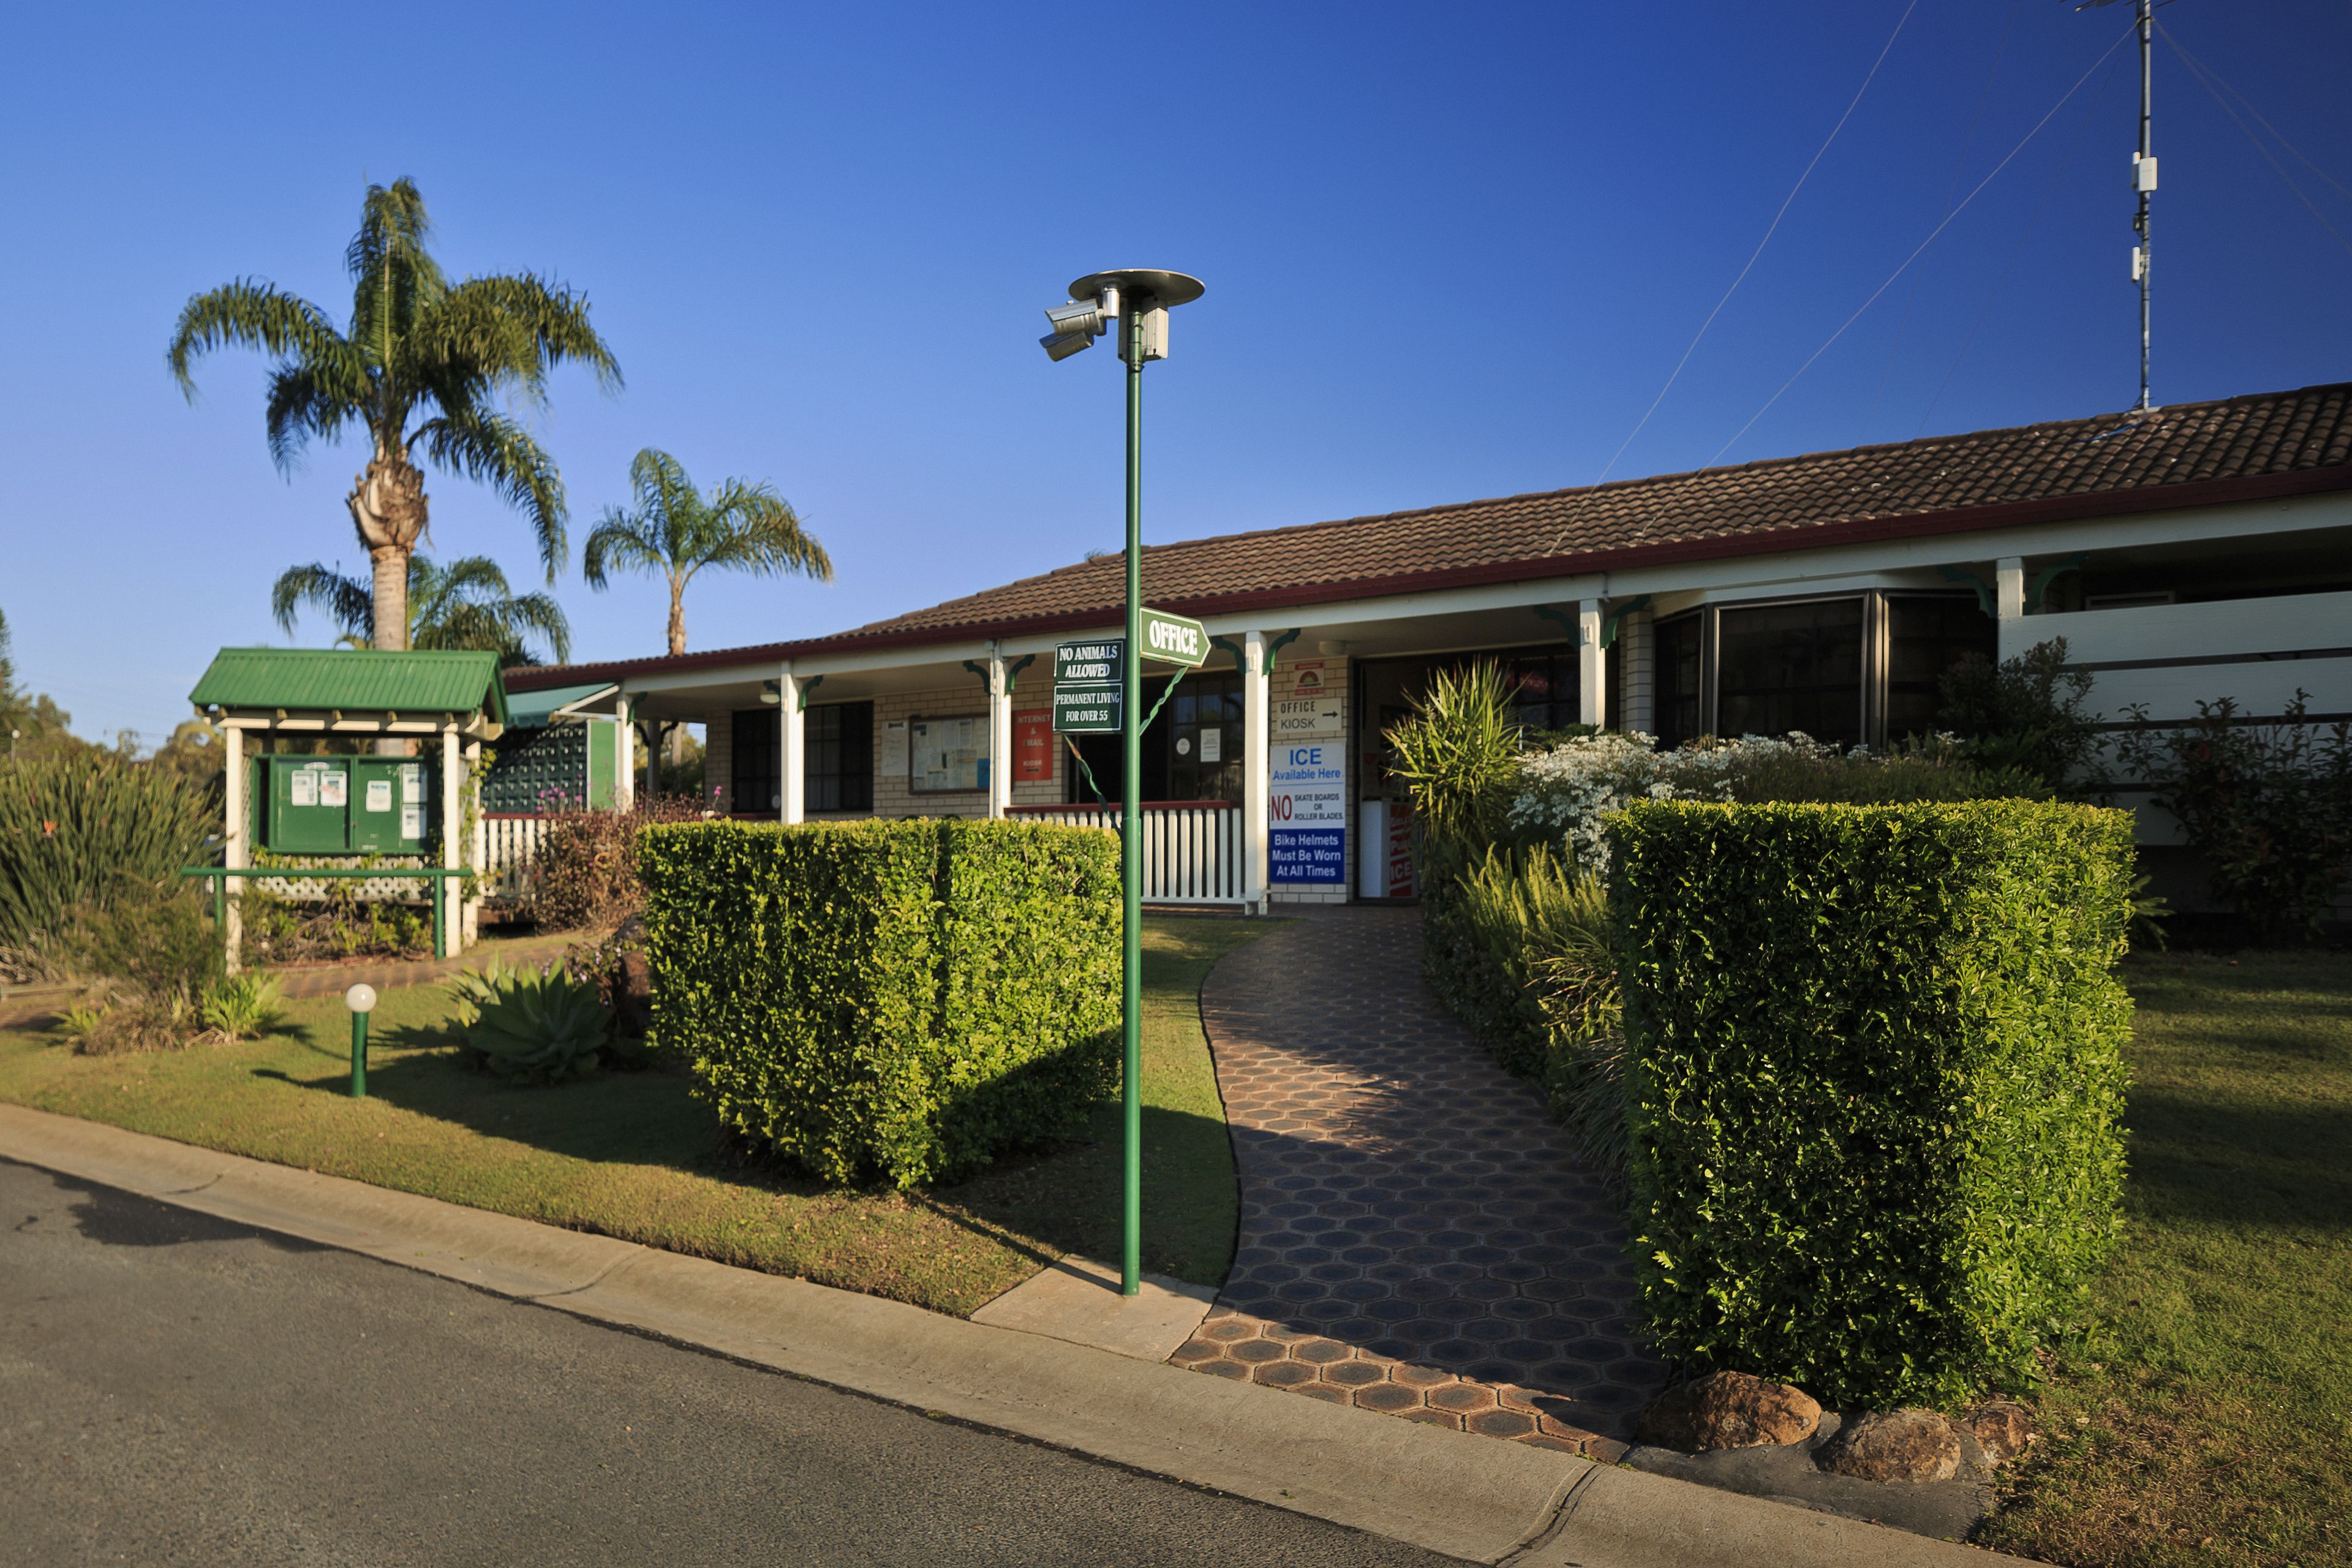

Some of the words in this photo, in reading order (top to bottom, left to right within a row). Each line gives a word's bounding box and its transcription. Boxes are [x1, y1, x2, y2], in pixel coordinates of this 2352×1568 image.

[1149, 619, 1198, 656] OFFICE
[1059, 648, 1074, 662] NO
[1074, 645, 1118, 660] ANIMALS
[1065, 663, 1110, 678] ALLOWED
[1056, 693, 1096, 705] PERMANENT
[1096, 692, 1120, 704] LIVING
[1280, 701, 1316, 714] OFFICE
[1017, 714, 1051, 723] NTERNET
[1066, 710, 1079, 722] FOR
[1080, 710, 1098, 722] OVER
[1099, 710, 1108, 721] 55
[1281, 718, 1316, 729] KIOSK
[1289, 748, 1322, 766] ICE
[1273, 769, 1316, 780] Available
[1318, 768, 1341, 779] Here
[1271, 794, 1292, 821] NO
[1275, 834, 1296, 846] Bike
[1298, 834, 1339, 845] Helmets
[1272, 850, 1296, 861] Must
[1298, 850, 1311, 861] Be
[1314, 850, 1341, 861] Worn
[1276, 865, 1287, 876] At
[1289, 865, 1303, 876] All
[1305, 865, 1336, 876] Times
[1390, 861, 1412, 880] ICE
